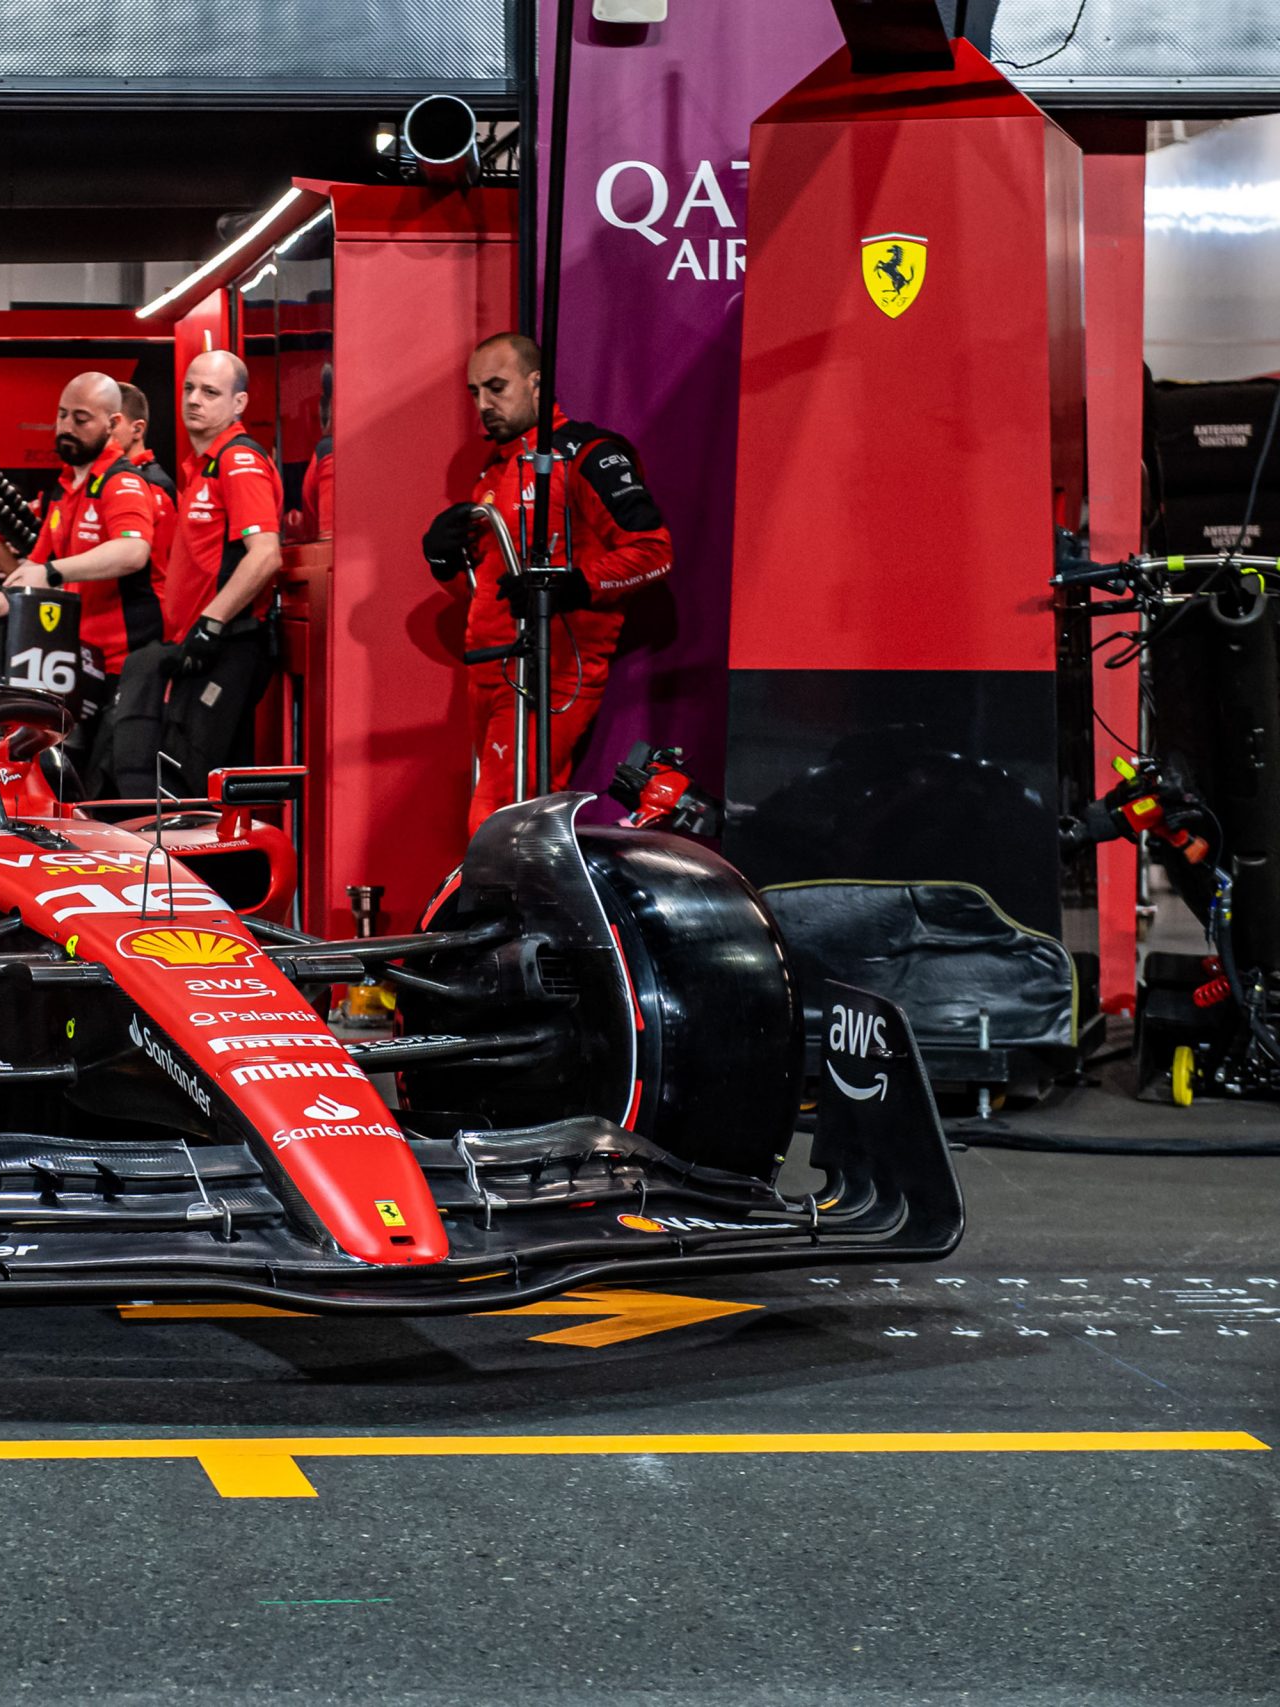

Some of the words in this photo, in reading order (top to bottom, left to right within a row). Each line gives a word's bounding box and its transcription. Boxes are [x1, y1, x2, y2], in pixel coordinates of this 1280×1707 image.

[1203, 525, 1261, 537] ANTERIRE
[1211, 537, 1252, 548] DESTO
[9, 646, 77, 694] 16
[34, 882, 236, 923] 16
[185, 978, 268, 991] aws
[219, 1010, 317, 1023] Palantir
[207, 1033, 342, 1054] PIRELLI
[829, 1004, 887, 1058] aws
[143, 1027, 211, 1117] Santander
[230, 1061, 370, 1087] MAHLE
[272, 1123, 407, 1150] Santander
